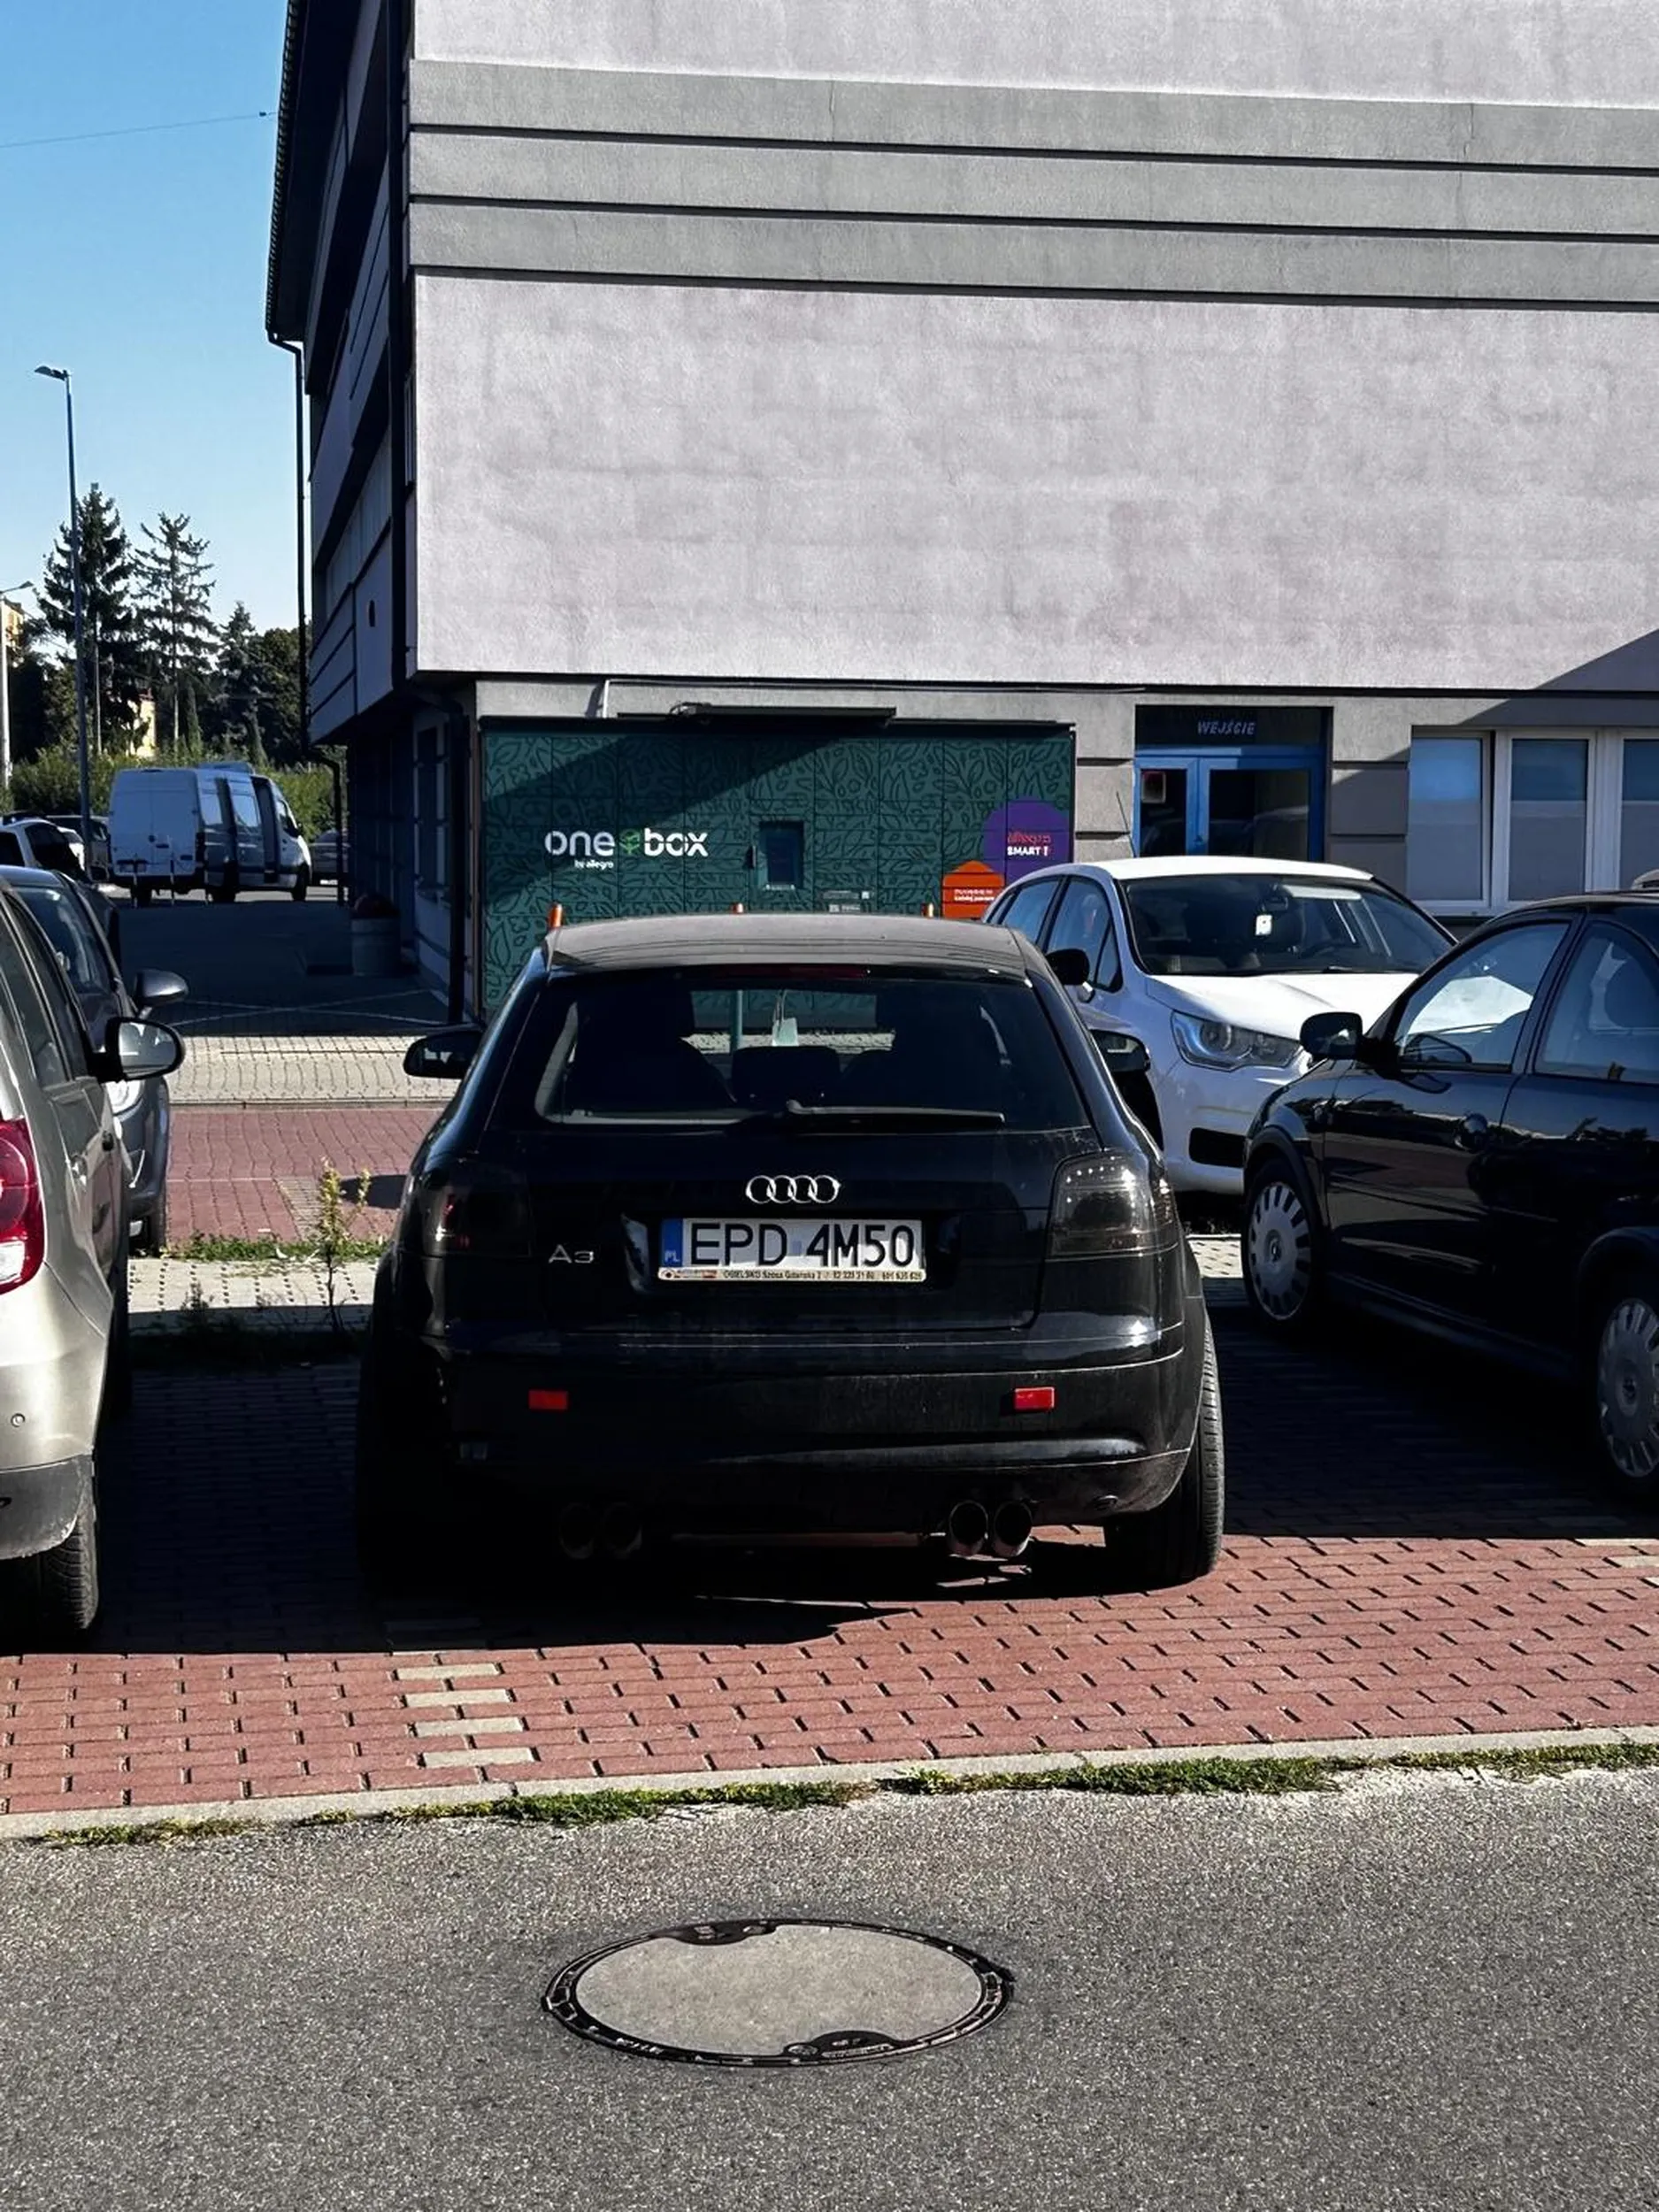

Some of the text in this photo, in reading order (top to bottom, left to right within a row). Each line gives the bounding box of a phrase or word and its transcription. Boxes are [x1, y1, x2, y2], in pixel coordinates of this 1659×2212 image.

[1197, 718, 1256, 735] WEJŚCIE
[544, 827, 709, 856] one box
[549, 1244, 594, 1263] A3
[691, 1223, 915, 1267] EPD 4M50
[664, 1250, 680, 1262] PL
